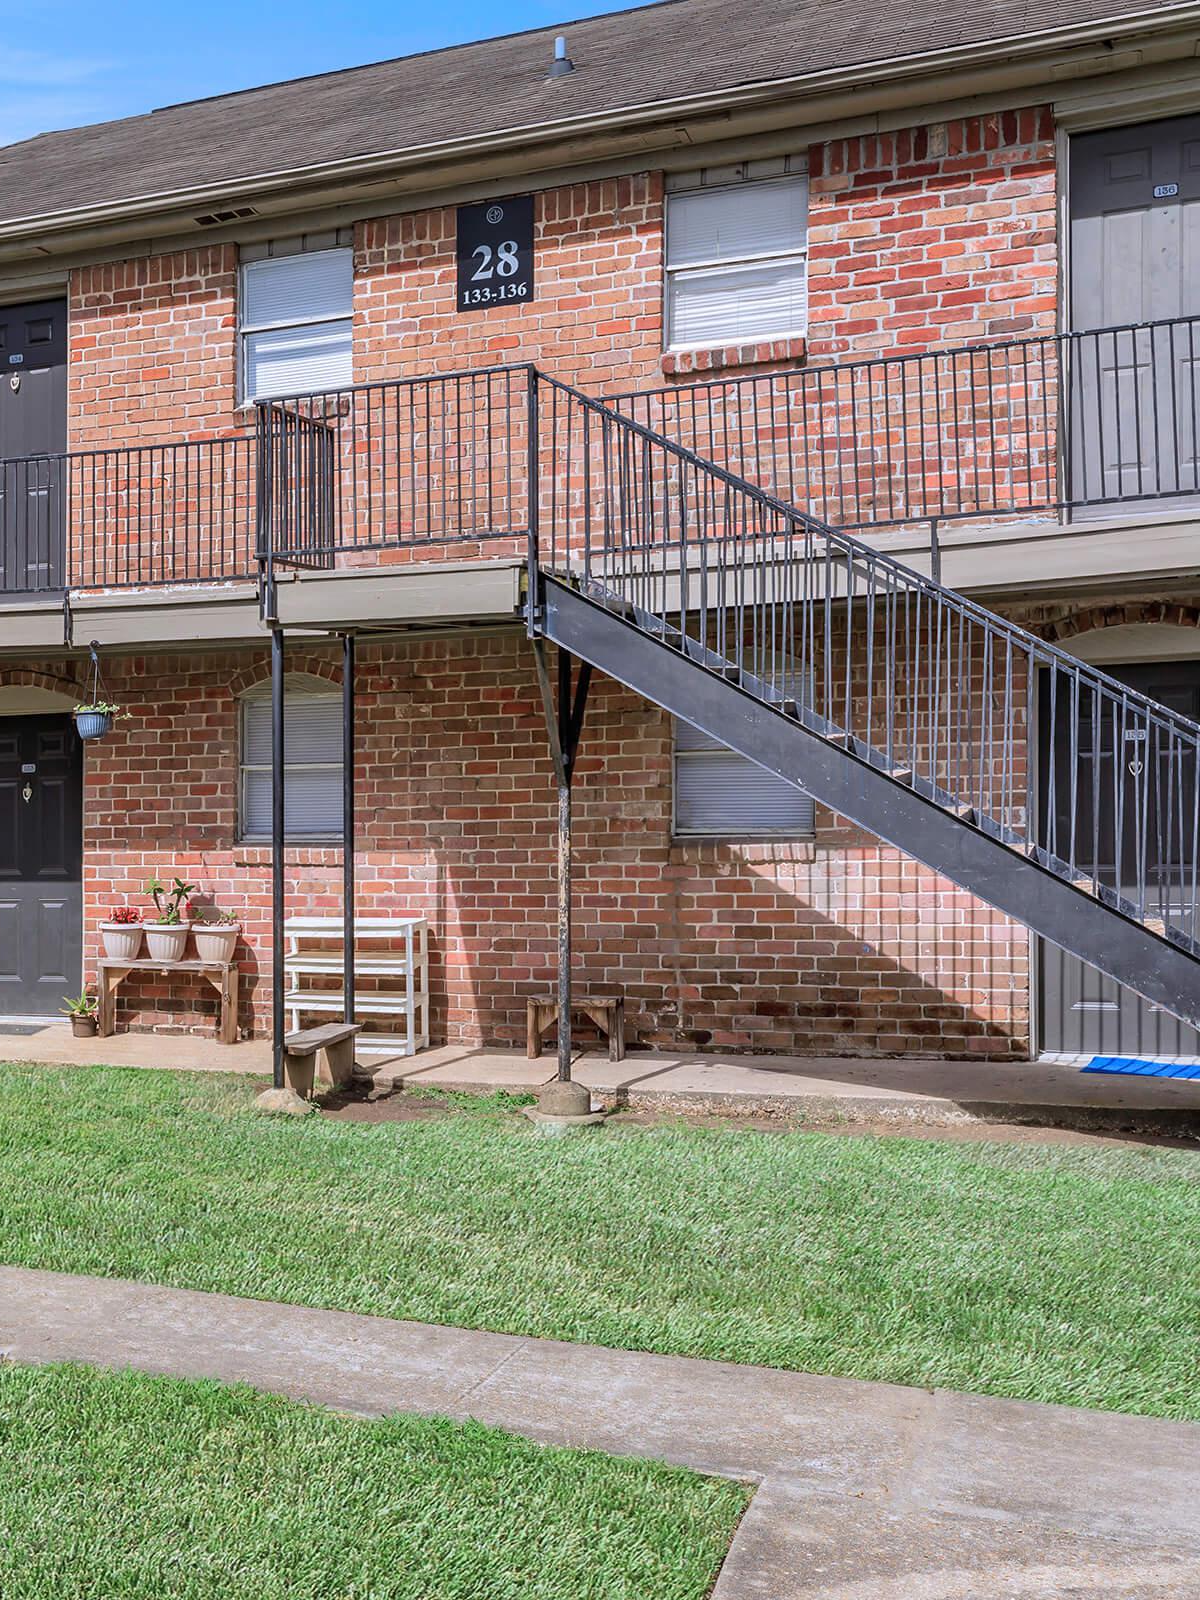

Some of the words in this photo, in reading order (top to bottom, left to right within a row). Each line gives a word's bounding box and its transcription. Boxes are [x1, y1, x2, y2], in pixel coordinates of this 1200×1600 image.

[1157, 186, 1175, 196] 136
[471, 240, 519, 280] 28
[463, 282, 527, 304] 133-136
